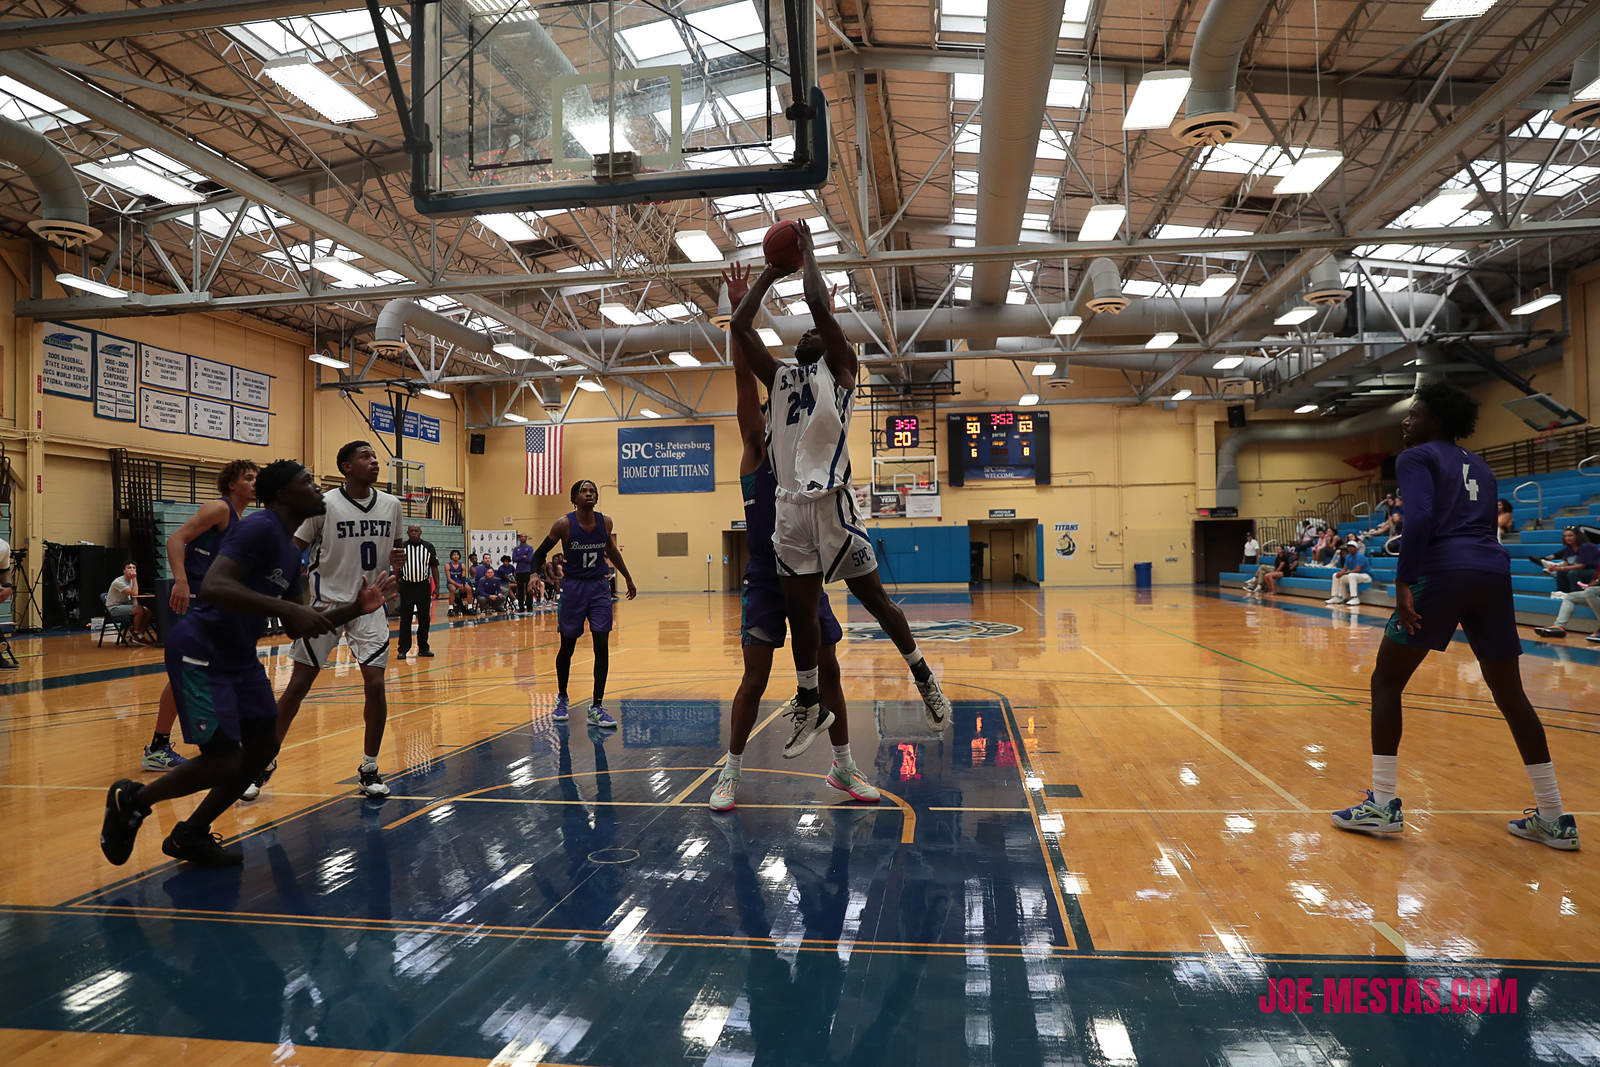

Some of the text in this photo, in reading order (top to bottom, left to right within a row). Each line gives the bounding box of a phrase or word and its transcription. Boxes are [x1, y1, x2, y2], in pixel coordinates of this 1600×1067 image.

[61, 355, 83, 365] BASEBALL
[45, 360, 86, 373] STATE CHAMPIONS
[56, 371, 71, 380] WORLD
[73, 374, 89, 382] SERIES
[103, 372, 129, 382] CONFERENCE
[104, 380, 128, 389] CHAMPIONS
[786, 383, 816, 426] 24
[895, 419, 917, 430] 3:52
[990, 413, 1013, 425] 3:52
[966, 422, 980, 434] 50
[1018, 420, 1033, 433] 63
[893, 431, 912, 447] 20
[621, 442, 653, 460] SPC
[655, 441, 711, 451] St. Petersburg
[1023, 447, 1030, 456] 8
[655, 450, 686, 460] College
[971, 448, 978, 458] 6
[623, 463, 709, 478] HOME OF THE TITANS
[1462, 463, 1479, 501] 4
[360, 541, 377, 571] 0
[582, 552, 598, 568] 12
[851, 547, 871, 567] SPC
